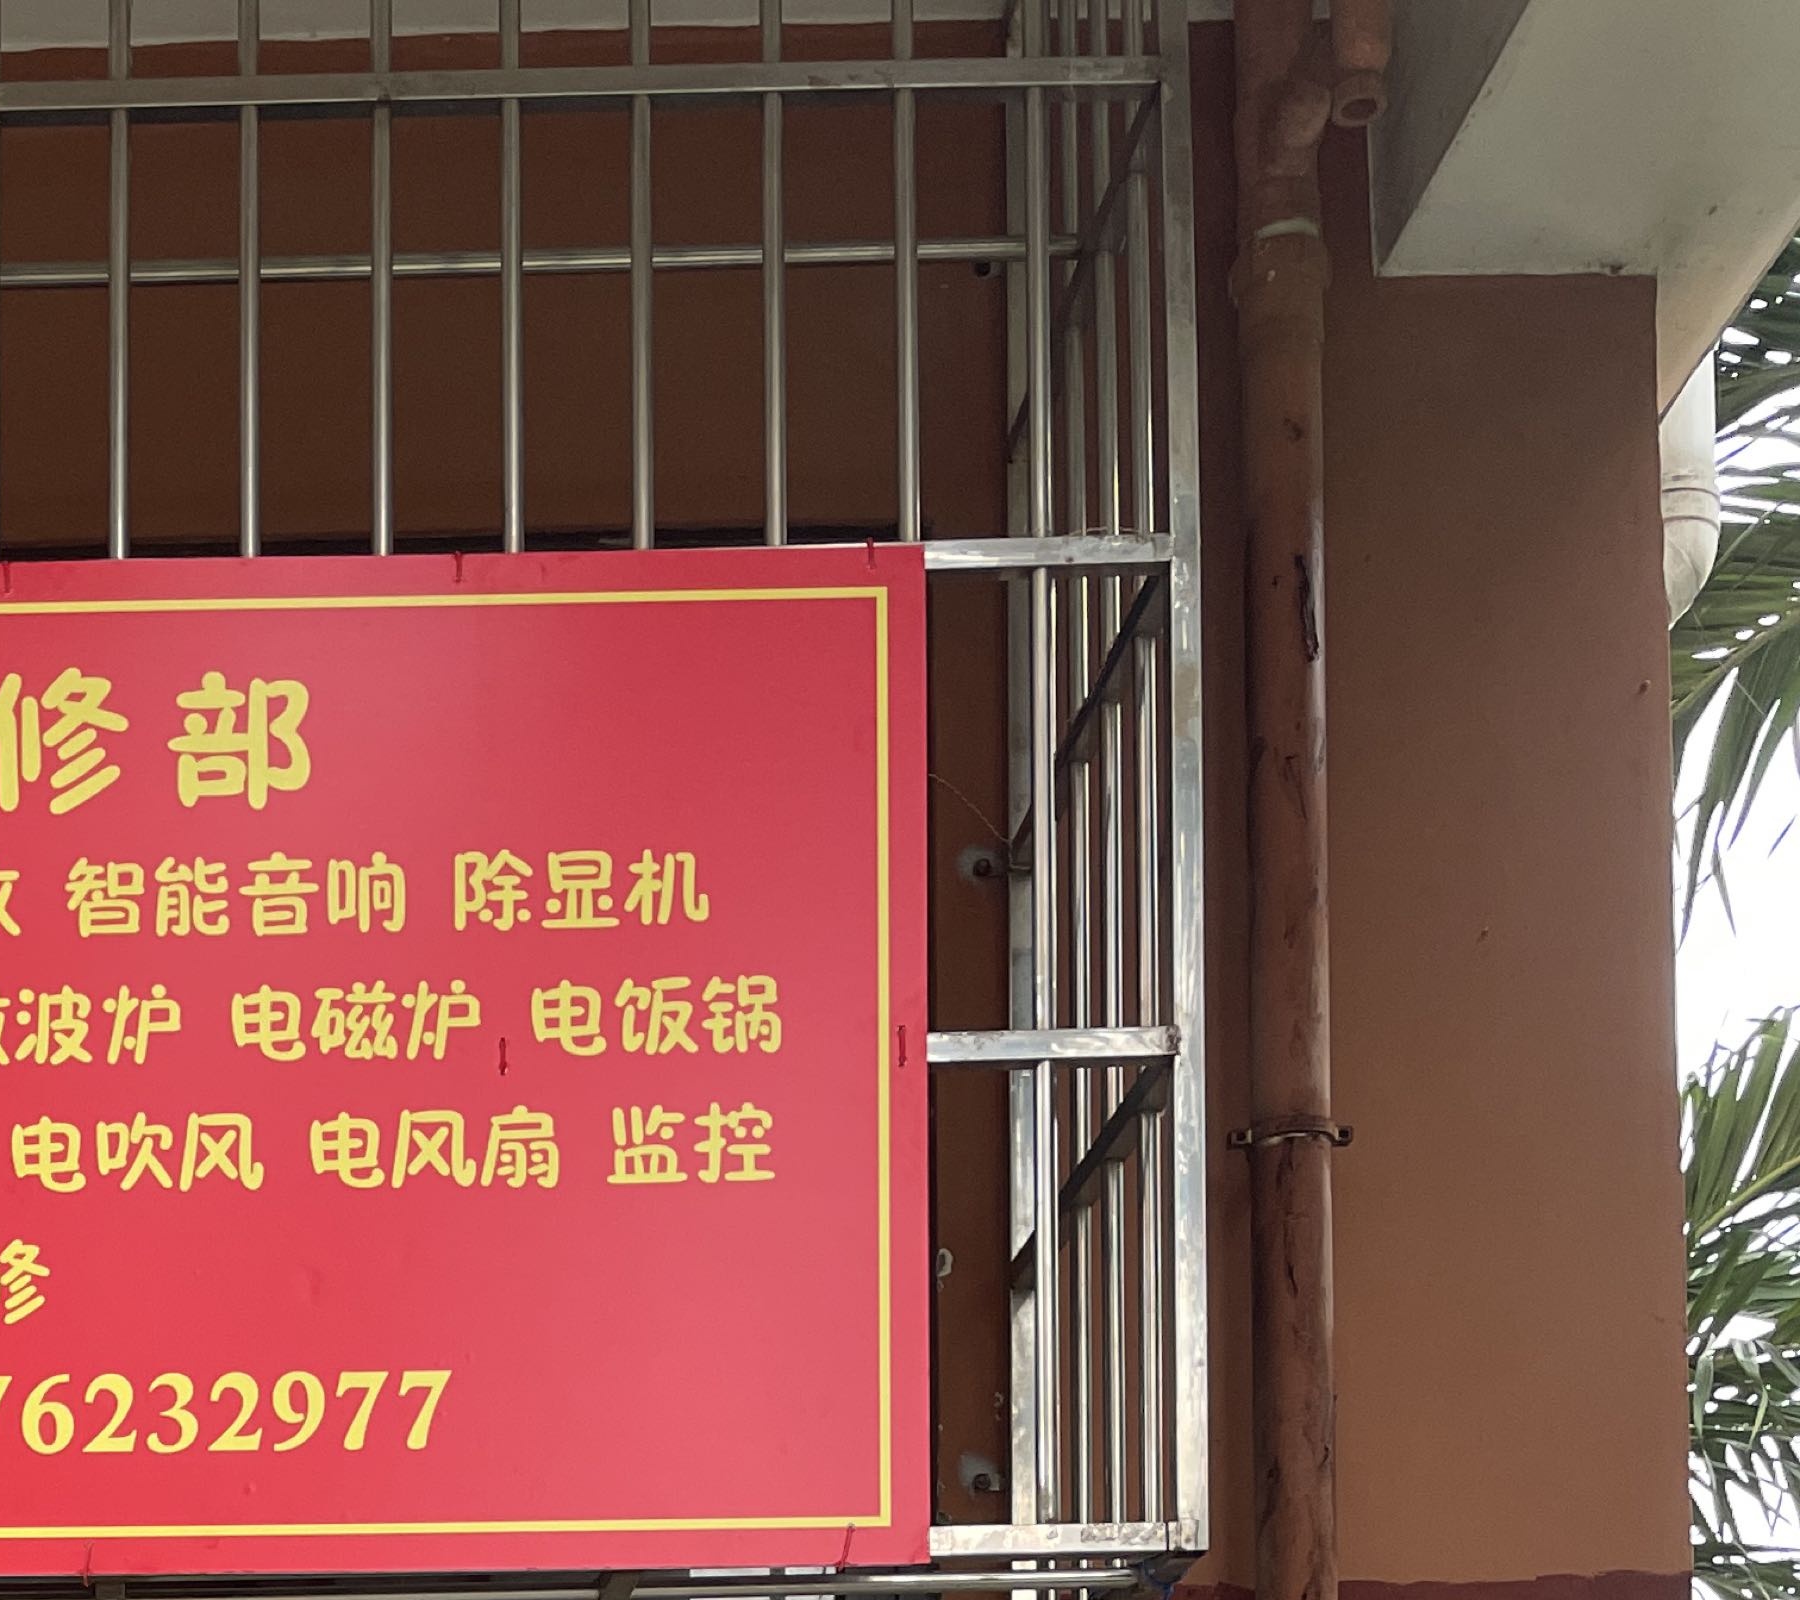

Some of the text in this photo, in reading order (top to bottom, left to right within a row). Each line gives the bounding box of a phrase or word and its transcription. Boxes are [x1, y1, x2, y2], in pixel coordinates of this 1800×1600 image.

[68, 854, 404, 935] 智能音响
[456, 849, 711, 931] 除显机
[231, 980, 480, 1061] 电磁炉
[531, 975, 783, 1056] 电饭锅
[11, 1112, 264, 1193] 电吹风
[310, 1105, 559, 1189] 电风扇
[607, 1102, 776, 1184] 监控
